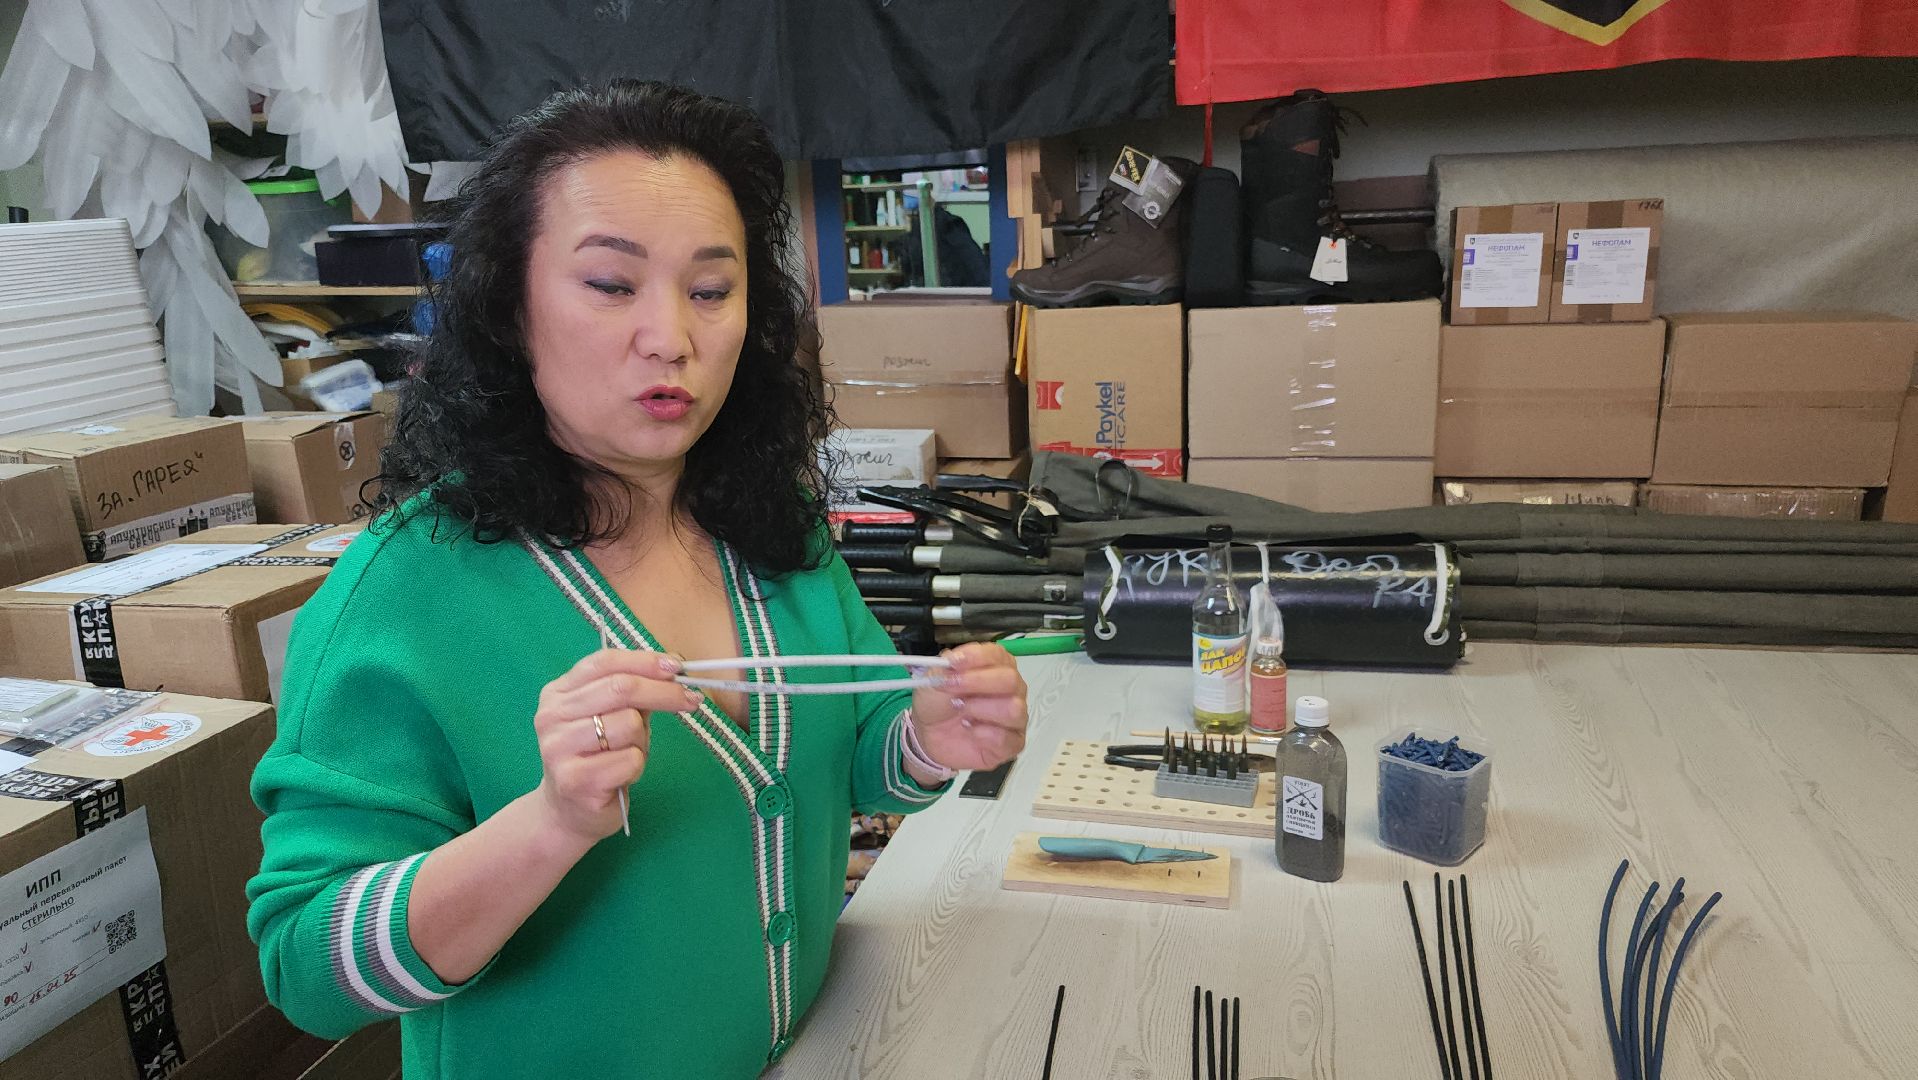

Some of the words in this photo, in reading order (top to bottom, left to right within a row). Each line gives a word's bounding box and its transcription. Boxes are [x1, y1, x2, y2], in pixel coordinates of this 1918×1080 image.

[1095, 381, 1117, 444] Paykel
[97, 491, 124, 520] ЗА
[1287, 807, 1316, 820] ДРОБЬ
[25, 869, 62, 898] ИПП
[40, 869, 103, 907] перевязочный
[104, 856, 128, 872] пакет
[21, 897, 75, 931] СТЕРИЛЬНО
